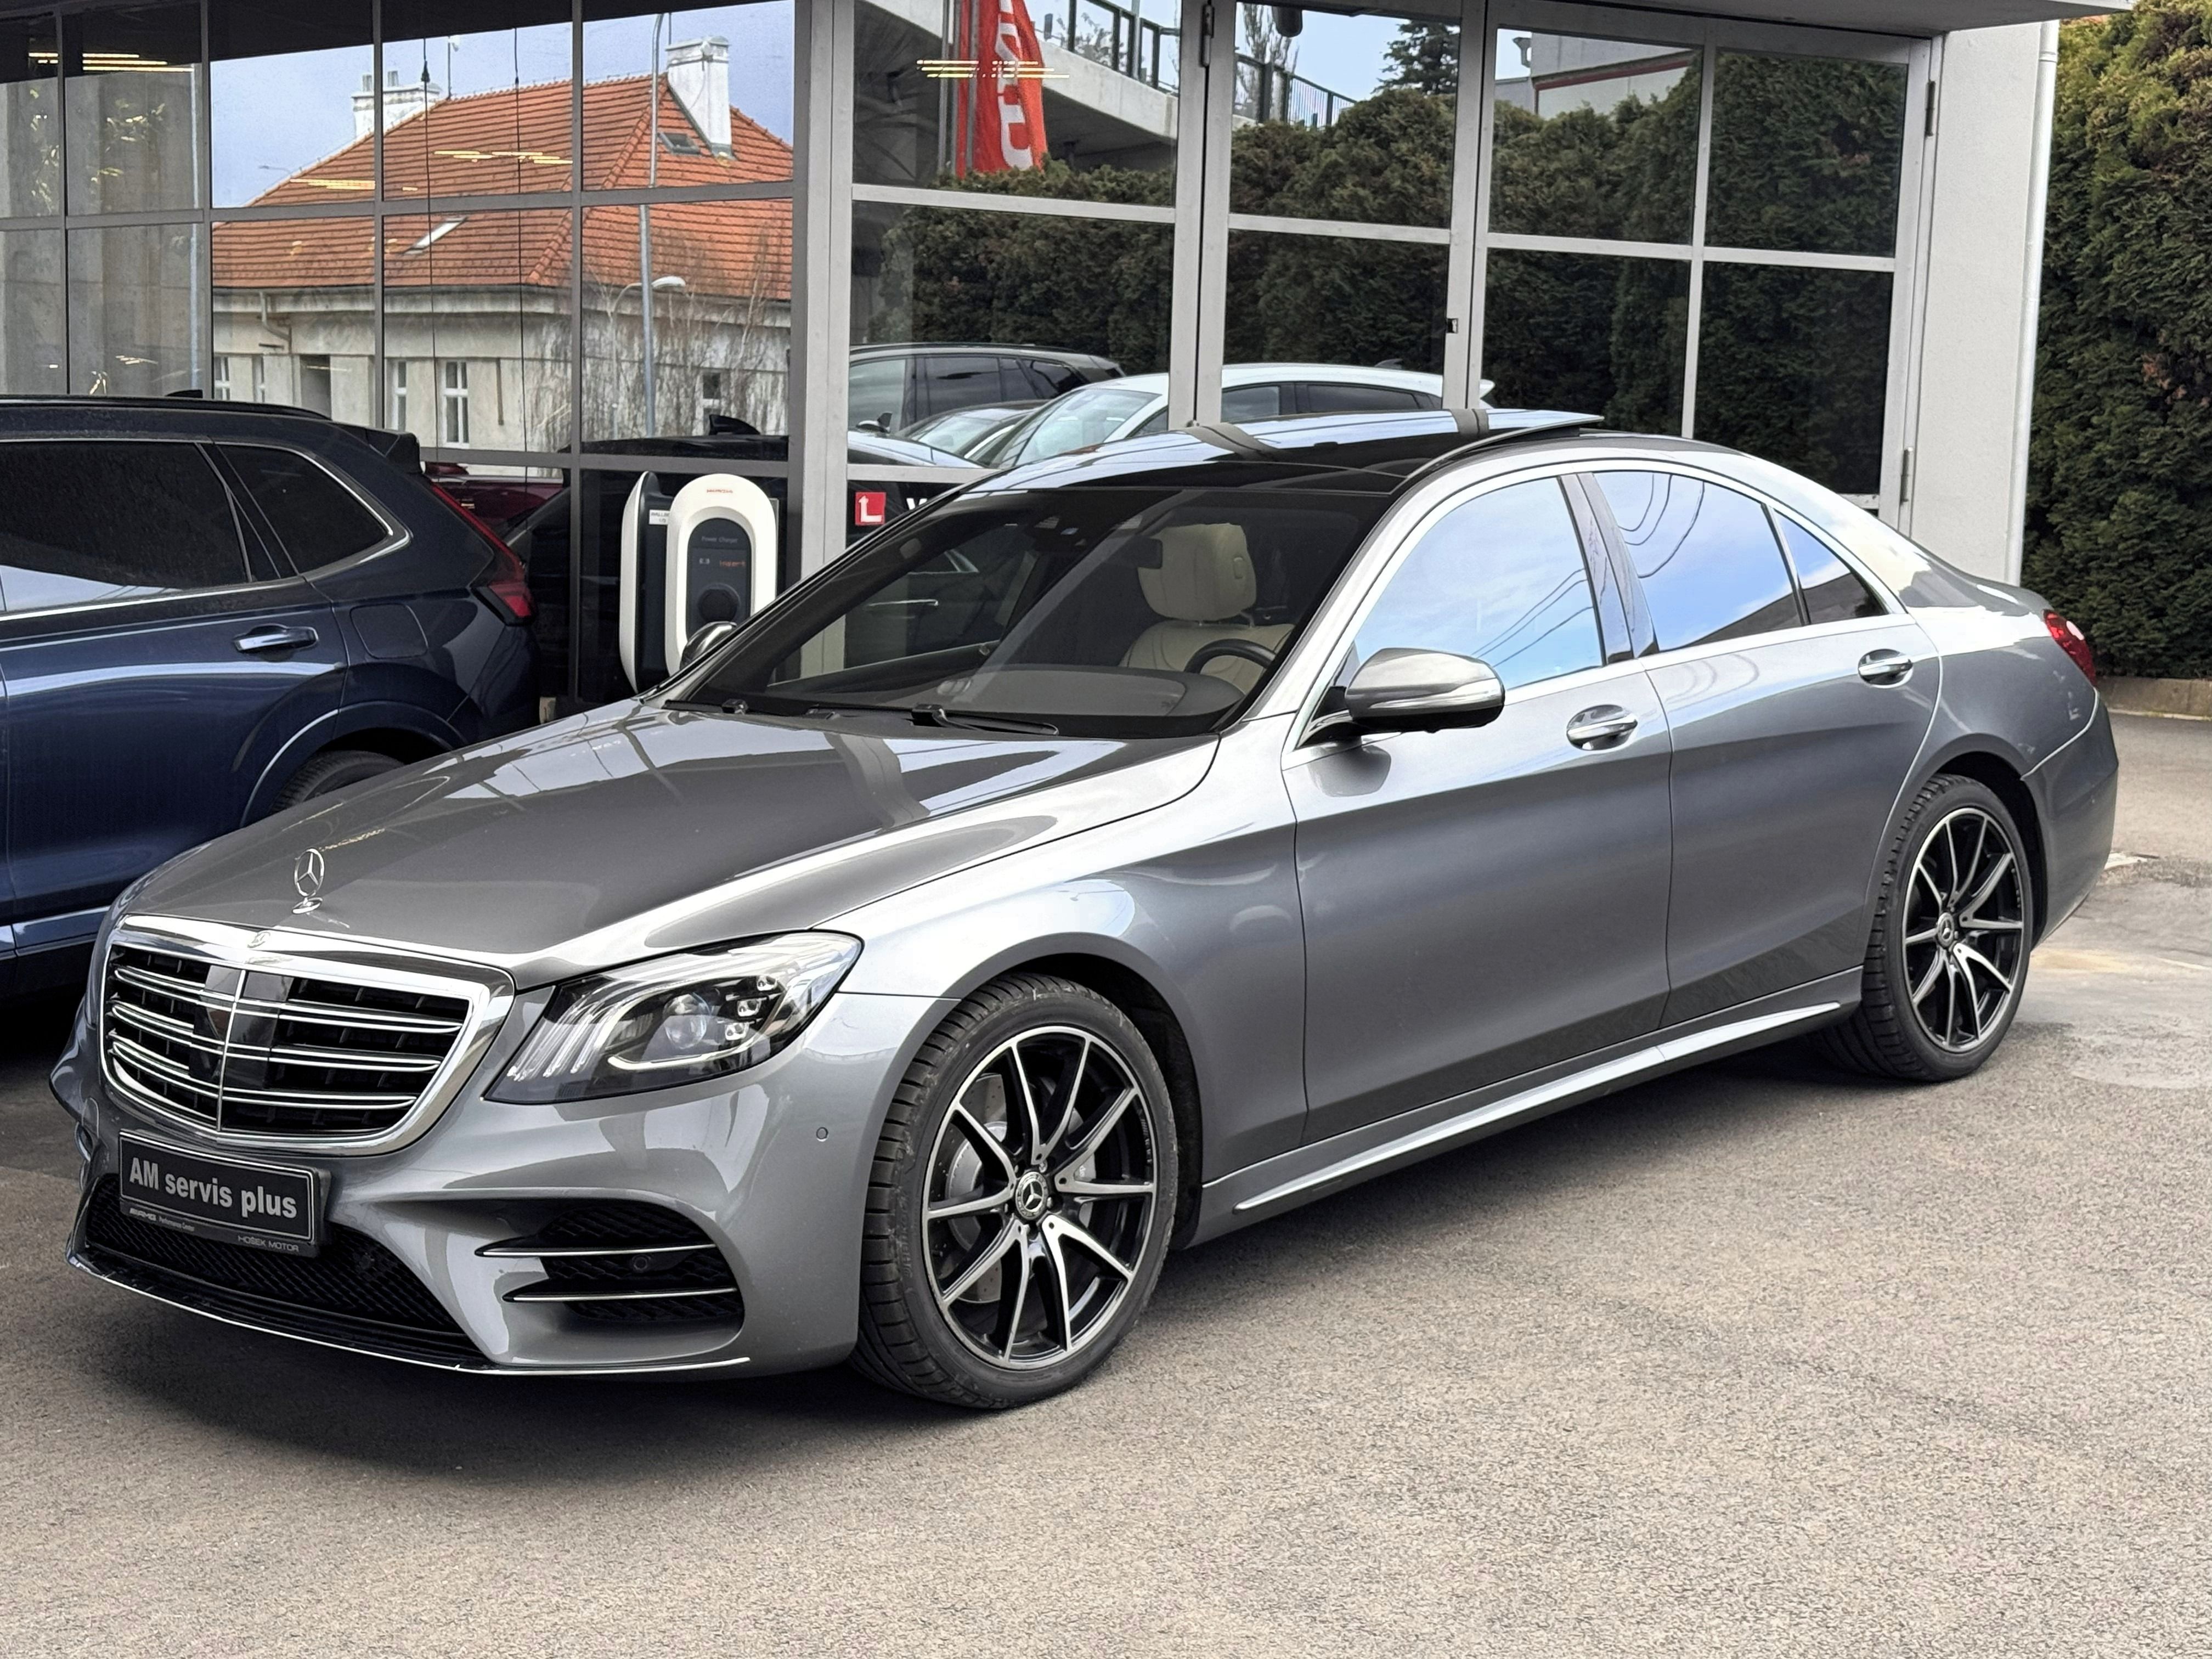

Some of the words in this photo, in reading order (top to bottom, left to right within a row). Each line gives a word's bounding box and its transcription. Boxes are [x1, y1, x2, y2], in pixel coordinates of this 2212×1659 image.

[129, 1157, 159, 1190] AM
[165, 1173, 233, 1208] servis
[241, 1186, 297, 1218] plus
[268, 1240, 299, 1252] MOTOR
